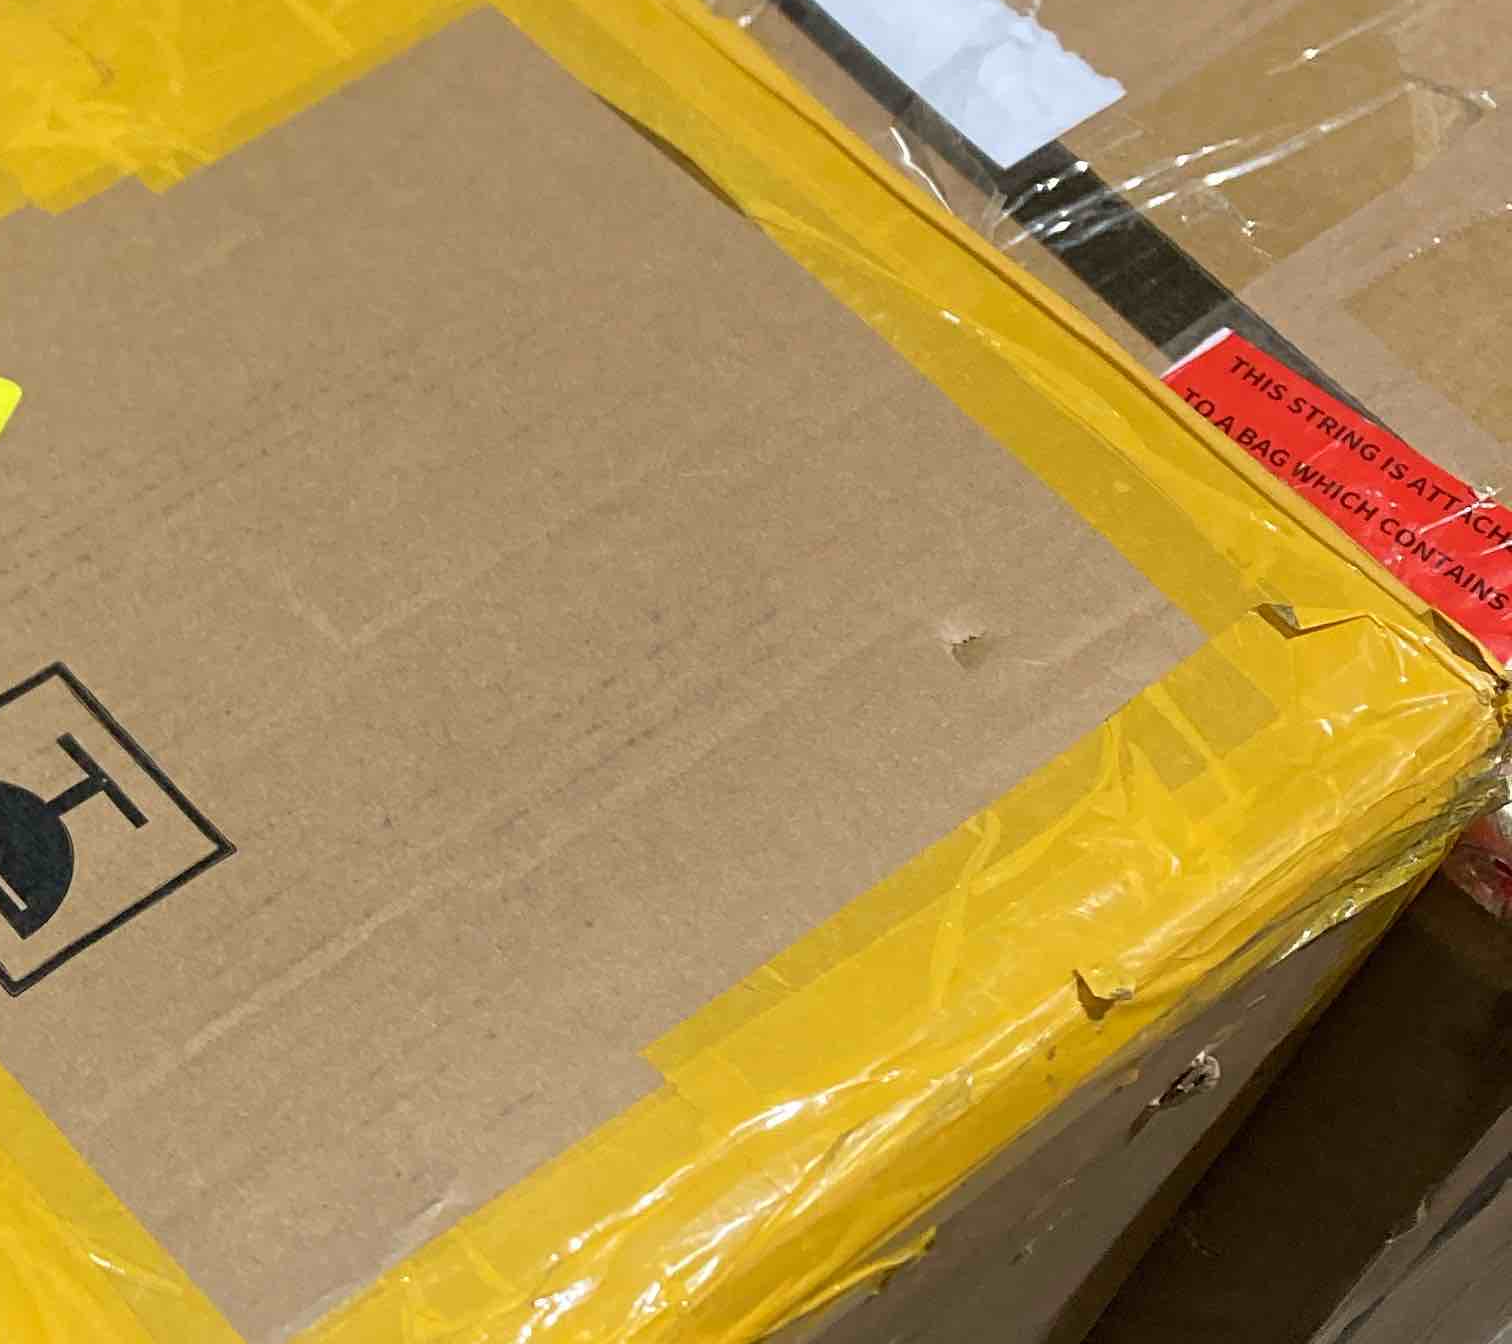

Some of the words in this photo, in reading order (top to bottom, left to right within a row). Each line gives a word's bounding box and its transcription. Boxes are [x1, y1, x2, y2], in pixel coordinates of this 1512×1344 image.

[1183, 386, 1216, 420] TO
[1213, 414, 1237, 438] A
[1236, 426, 1292, 469] BAG
[1290, 461, 1379, 523] WHICH
[1378, 517, 1512, 612] CONTAINS
[1229, 355, 1289, 402] THIS
[1287, 396, 1382, 463] STRING
[1380, 457, 1410, 482] IS
[1406, 476, 1512, 552] ATTACH
